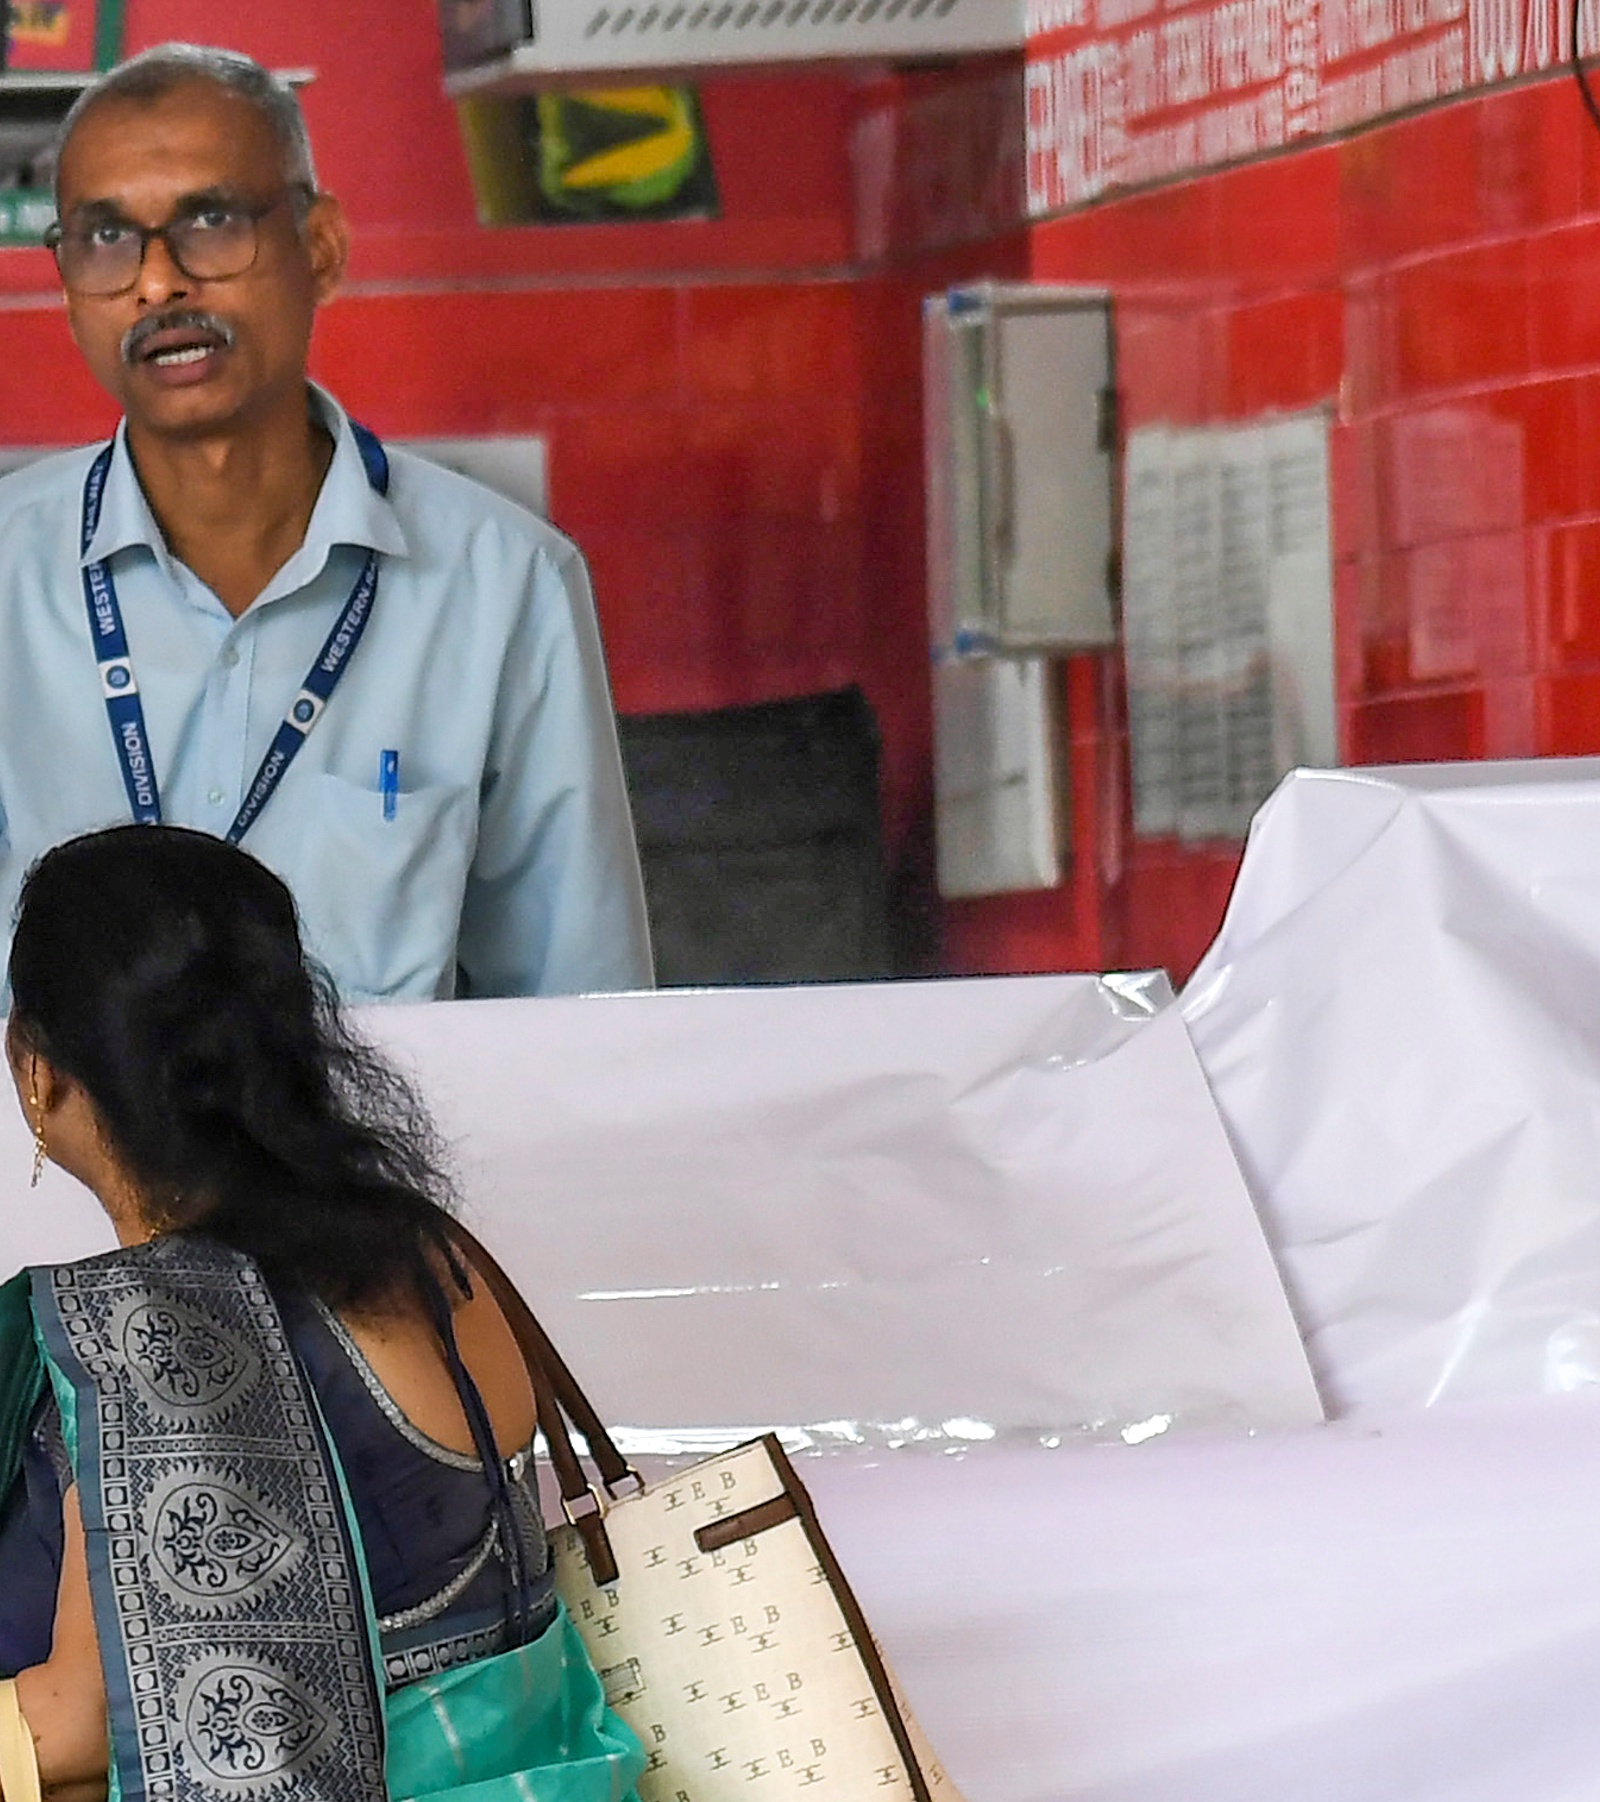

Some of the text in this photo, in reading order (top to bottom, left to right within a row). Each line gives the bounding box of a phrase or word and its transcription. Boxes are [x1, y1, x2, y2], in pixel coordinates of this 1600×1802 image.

[320, 585, 374, 674] WESTERN
[121, 722, 153, 807] DIVISION
[237, 750, 287, 827] DIVISION
